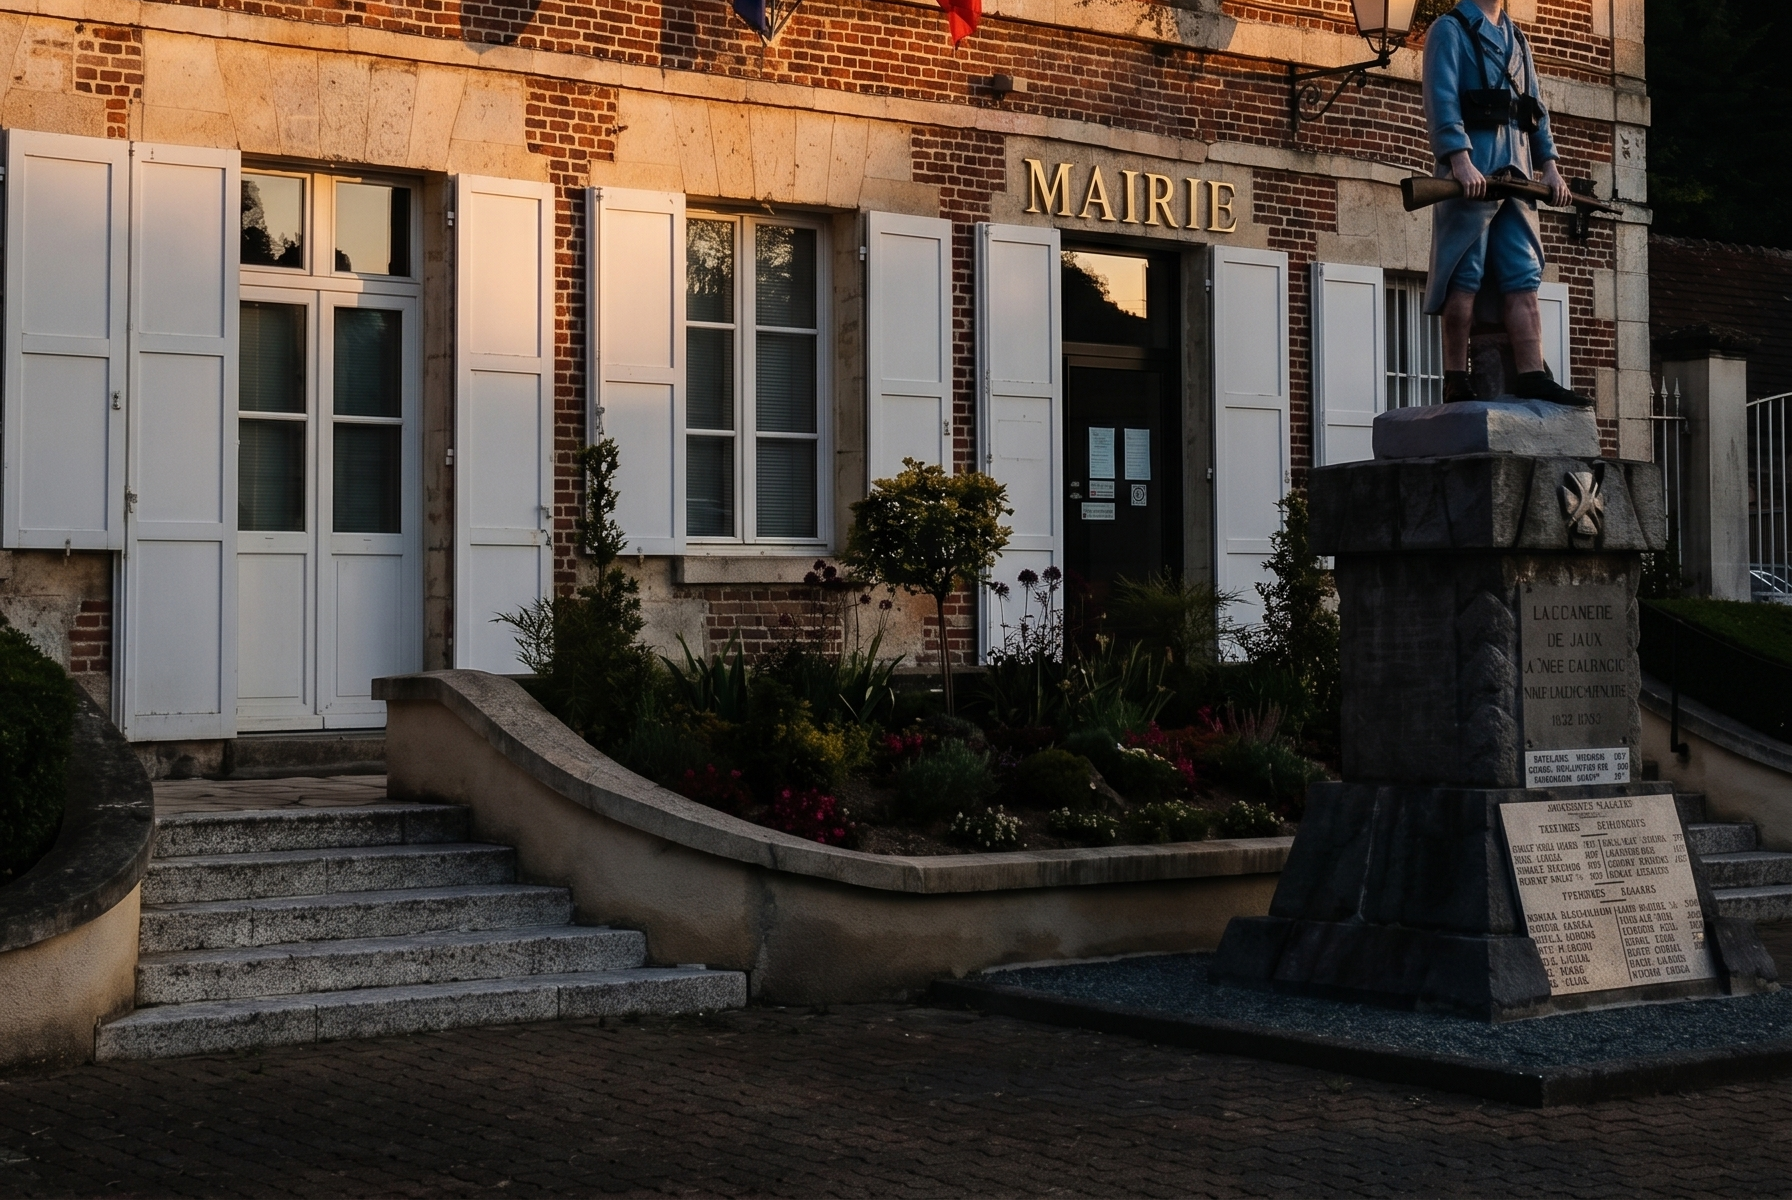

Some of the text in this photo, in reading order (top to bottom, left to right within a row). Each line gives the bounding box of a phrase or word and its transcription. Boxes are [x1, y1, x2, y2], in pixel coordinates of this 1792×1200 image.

[1023, 158, 1238, 233] MAIRIE
[1547, 632, 1603, 648] DE JAUX
